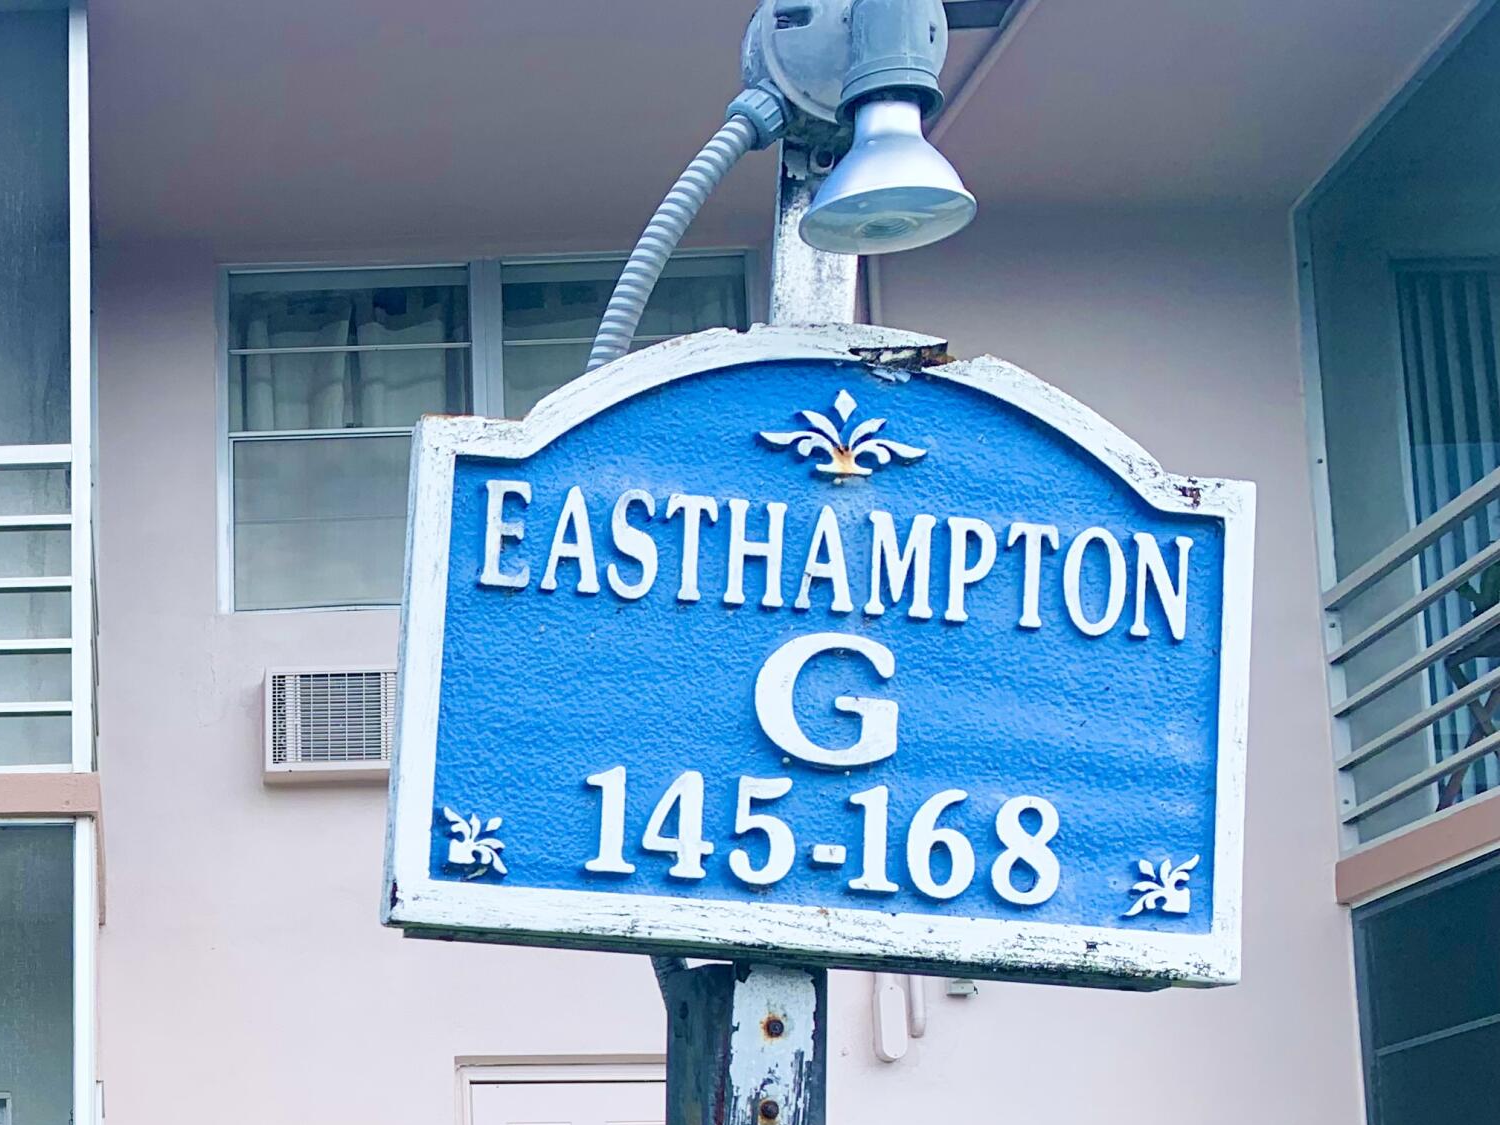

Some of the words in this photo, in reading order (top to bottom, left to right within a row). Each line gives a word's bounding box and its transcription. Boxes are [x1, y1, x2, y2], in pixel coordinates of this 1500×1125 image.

[480, 479, 1195, 642] EASTHAMPTON
[754, 632, 900, 767] G
[584, 765, 1062, 907] 145-168
